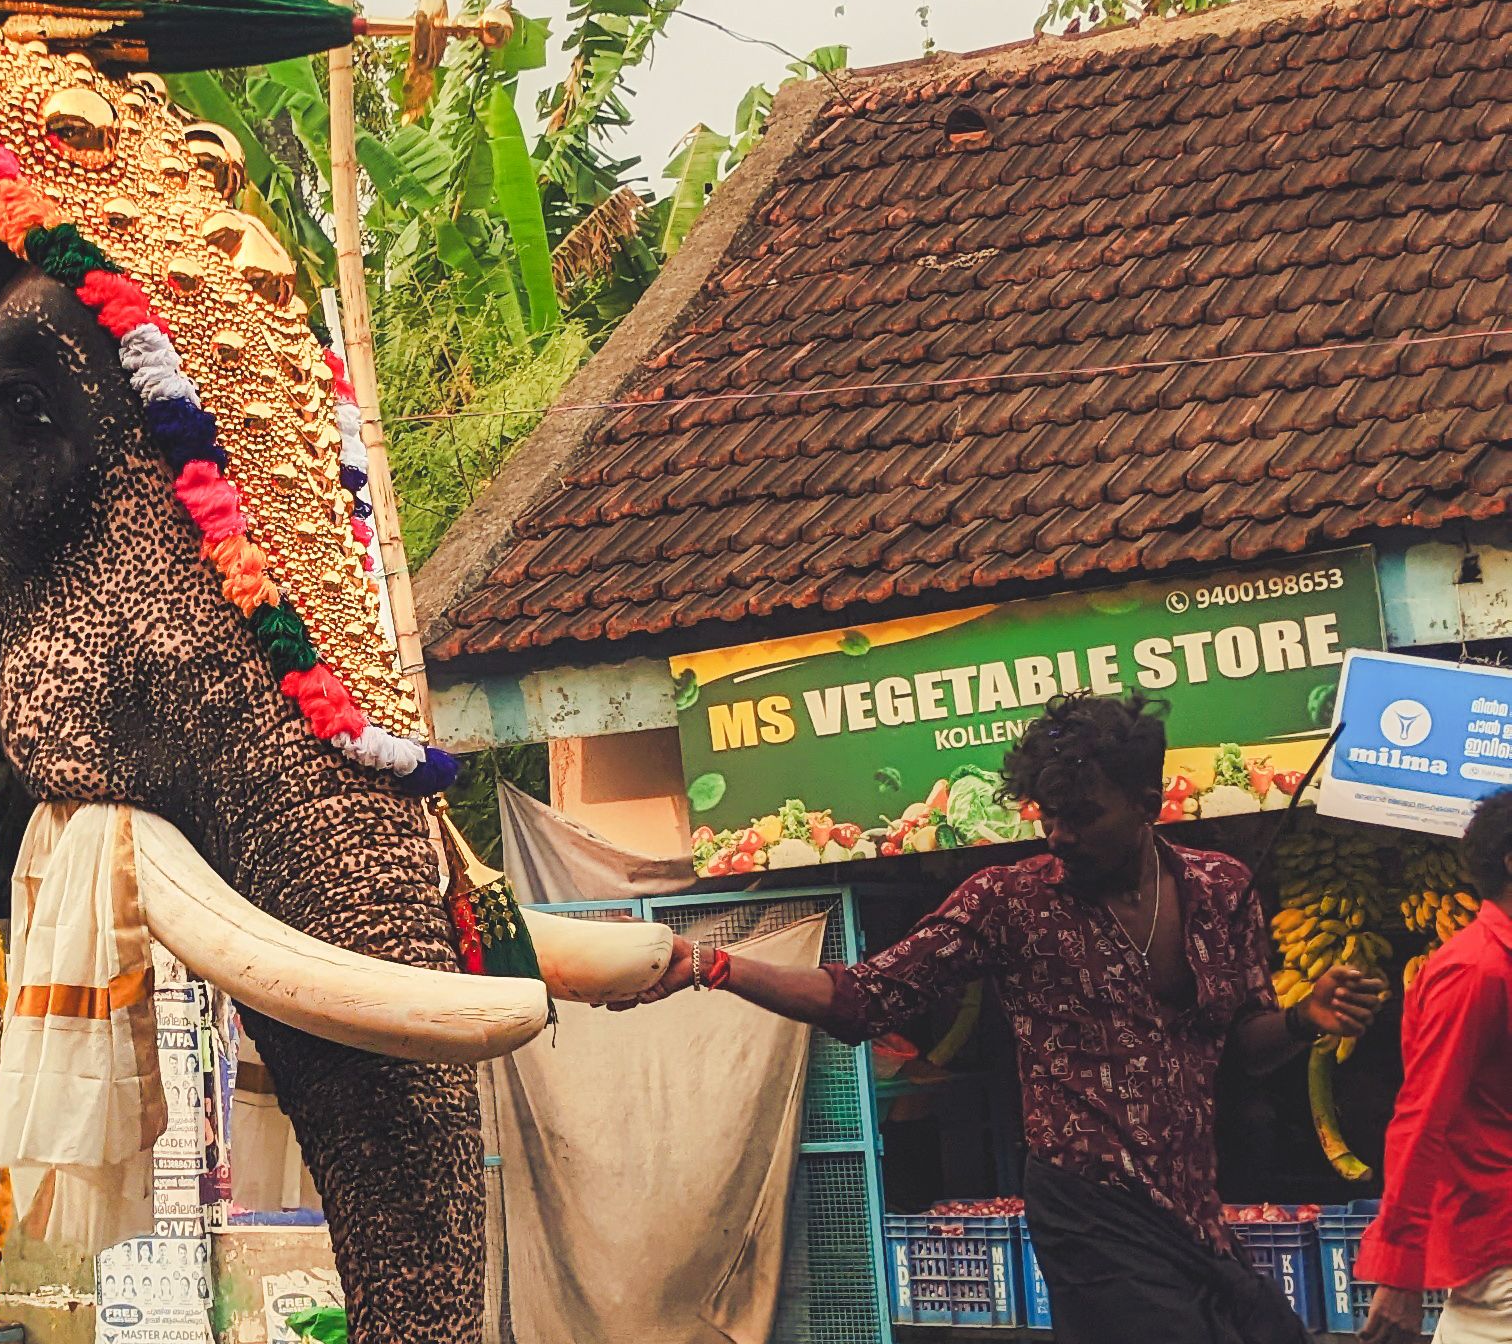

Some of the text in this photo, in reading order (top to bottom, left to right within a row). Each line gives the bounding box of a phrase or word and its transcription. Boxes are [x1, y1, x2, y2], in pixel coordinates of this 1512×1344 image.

[1195, 568, 1344, 609] 9400198653
[707, 613, 1344, 752] MS VEGETABLE STORE
[934, 717, 1039, 751] KOLLEN
[1347, 747, 1448, 776] milma
[895, 1245, 911, 1307] KDR
[1331, 1248, 1349, 1314] KDR
[105, 1308, 139, 1318] FREE
[277, 1297, 313, 1308] FREE
[121, 1329, 210, 1342] MASTER ACADEMY
